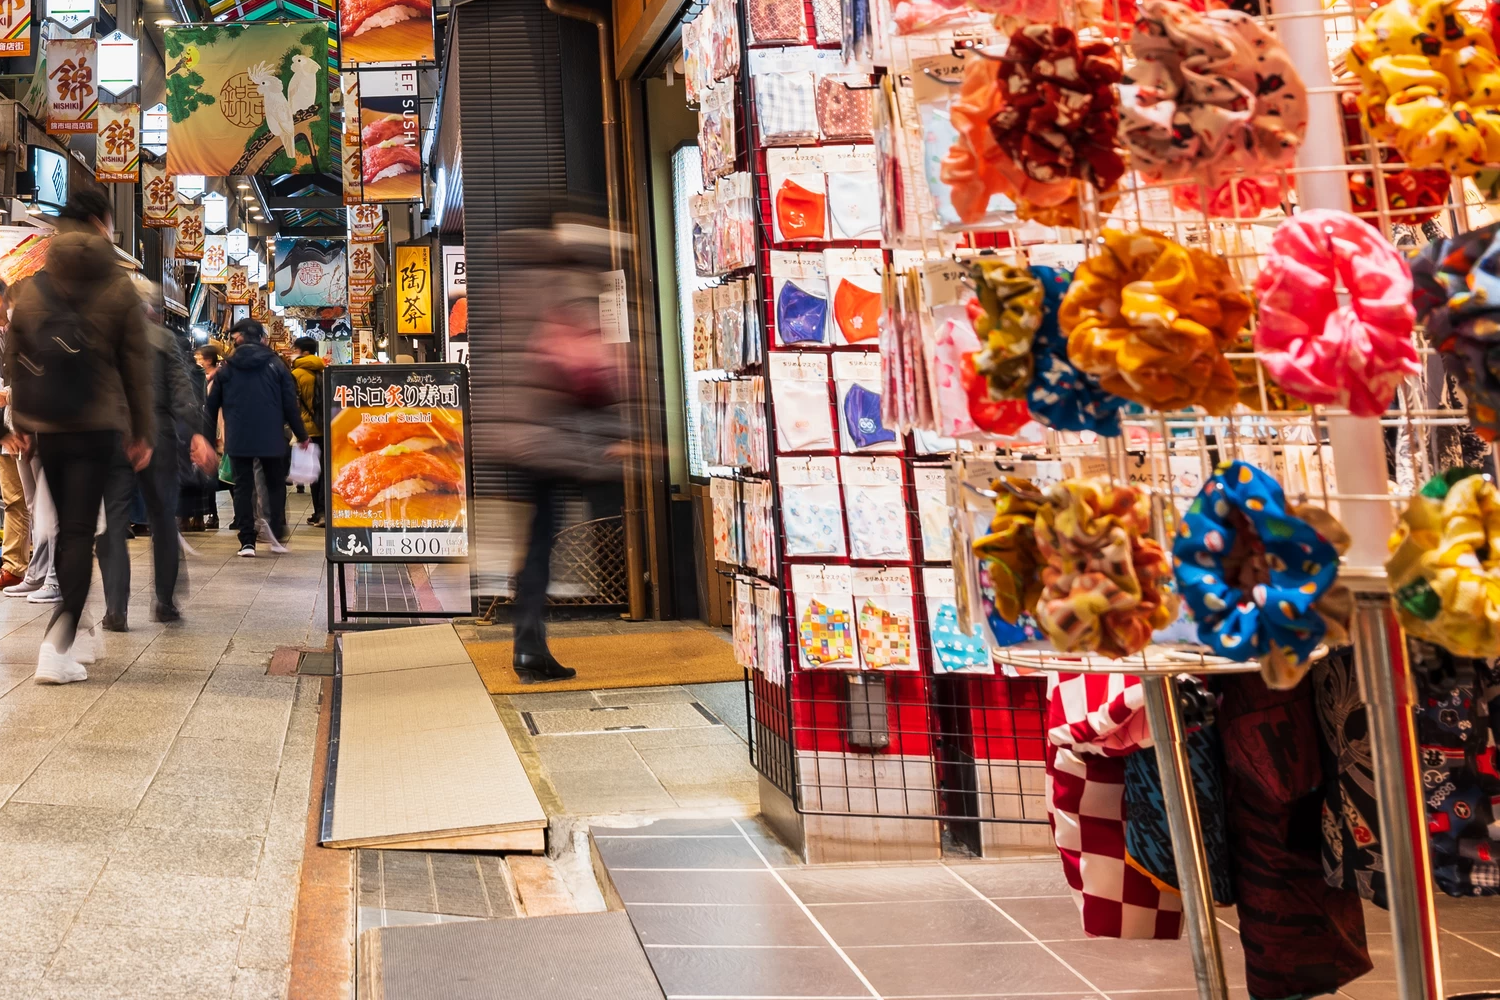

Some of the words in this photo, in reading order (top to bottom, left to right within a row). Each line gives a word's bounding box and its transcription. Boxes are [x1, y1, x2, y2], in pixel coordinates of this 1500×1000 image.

[49, 57, 94, 112] 錦
[53, 102, 79, 110] NISHIKI
[50, 121, 93, 130] 錦市場商店街
[402, 99, 416, 147] SUSHI
[99, 118, 135, 164] 錦
[356, 375, 383, 384] ぎゅうとろ
[334, 384, 459, 408] 牛トロ炙り寿司
[361, 413, 390, 423] Beef
[397, 412, 432, 423] Sushi
[401, 537, 440, 555] 800
